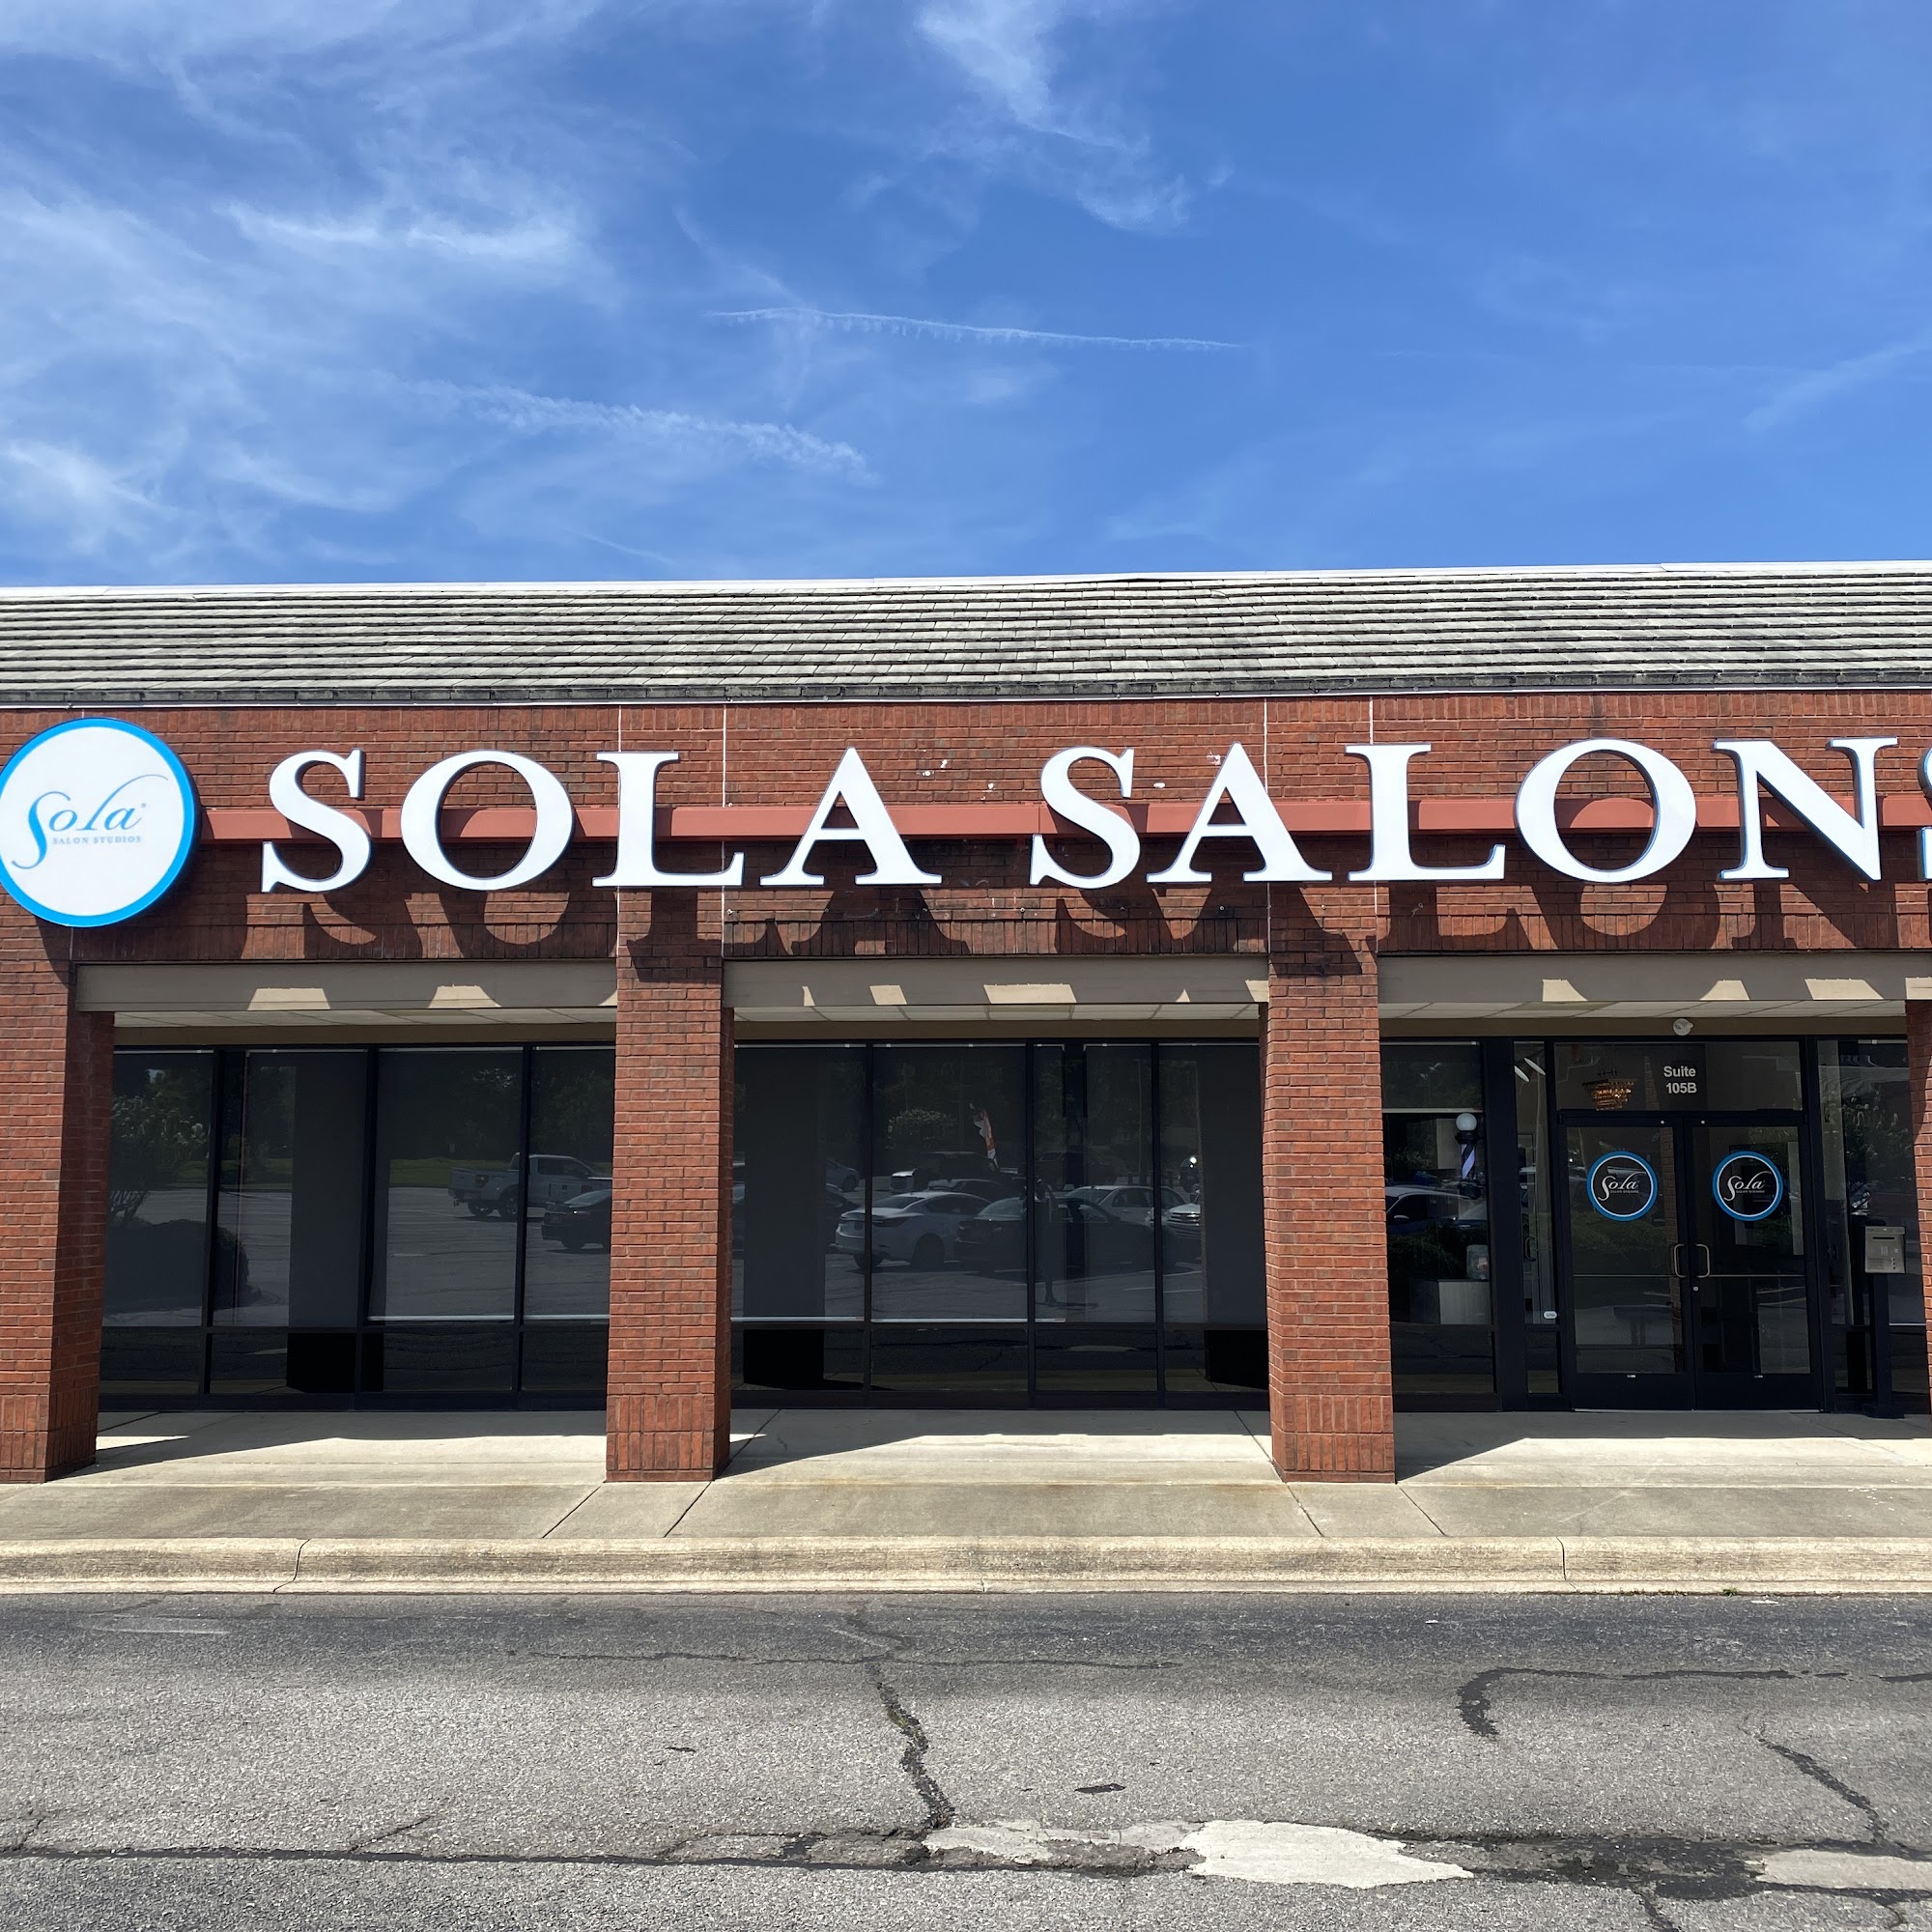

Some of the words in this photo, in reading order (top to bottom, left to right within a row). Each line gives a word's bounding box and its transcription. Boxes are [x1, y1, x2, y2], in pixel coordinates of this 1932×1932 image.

[261, 747, 942, 893] SOLA
[1029, 736, 1932, 889] SALON
[52, 837, 89, 845] SALON
[93, 835, 142, 844] STUDIOS
[1663, 1065, 1696, 1077] Suite
[1665, 1082, 1697, 1094] 105B
[1597, 1171, 1647, 1202] Sola
[1723, 1170, 1772, 1202] Sola
